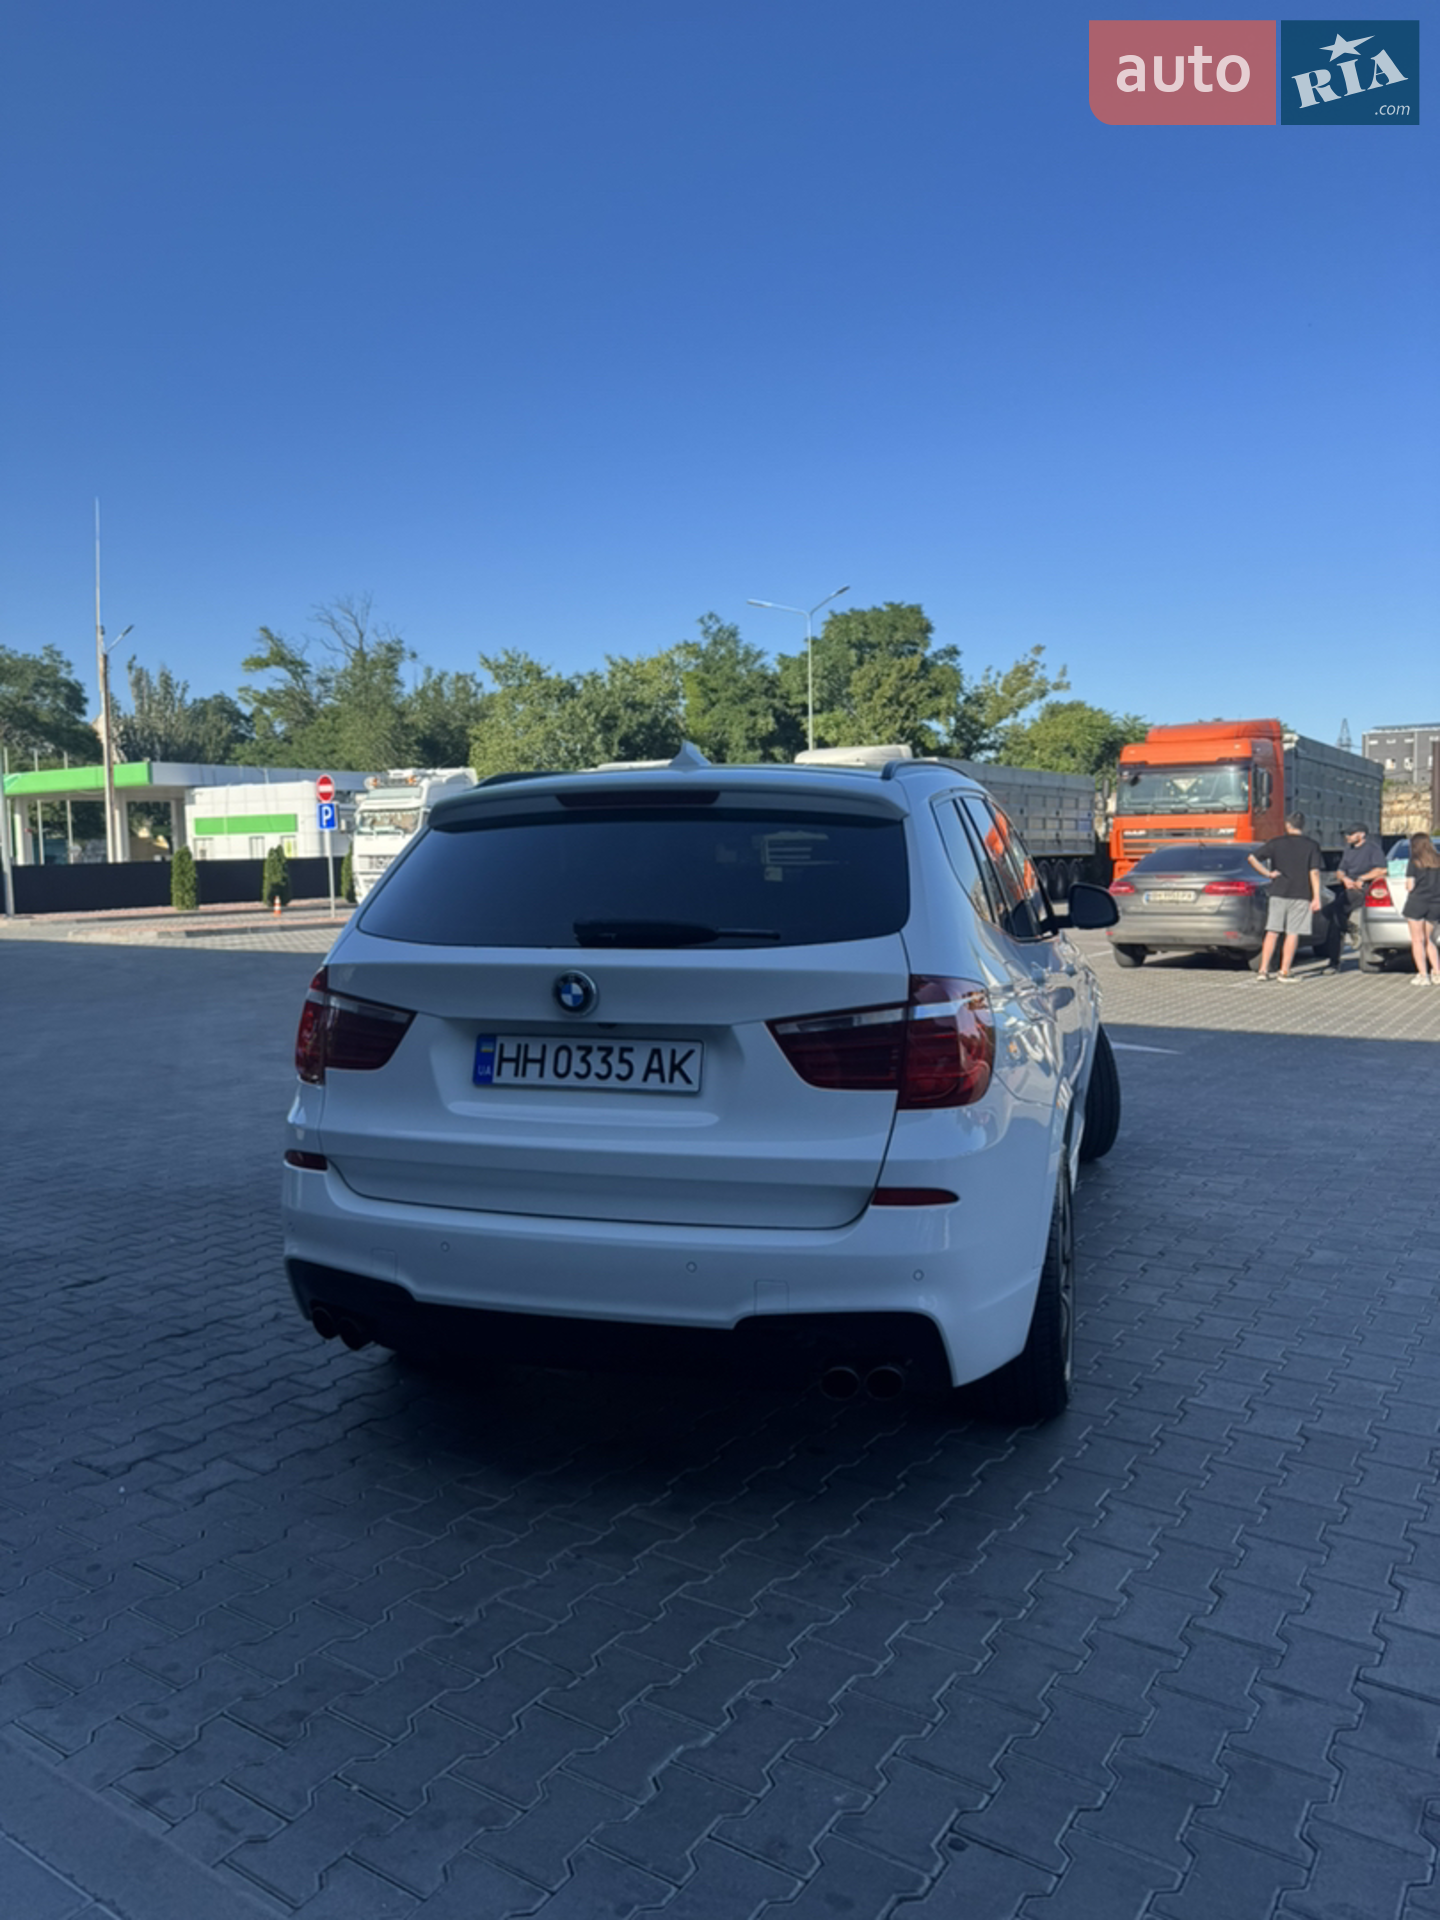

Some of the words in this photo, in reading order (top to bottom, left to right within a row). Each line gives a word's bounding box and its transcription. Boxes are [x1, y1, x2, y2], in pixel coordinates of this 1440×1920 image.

[322, 806, 333, 827] P
[477, 1065, 492, 1076] UA
[496, 1043, 547, 1078] HH
[553, 1044, 634, 1081] 0335
[642, 1047, 695, 1085] AK
